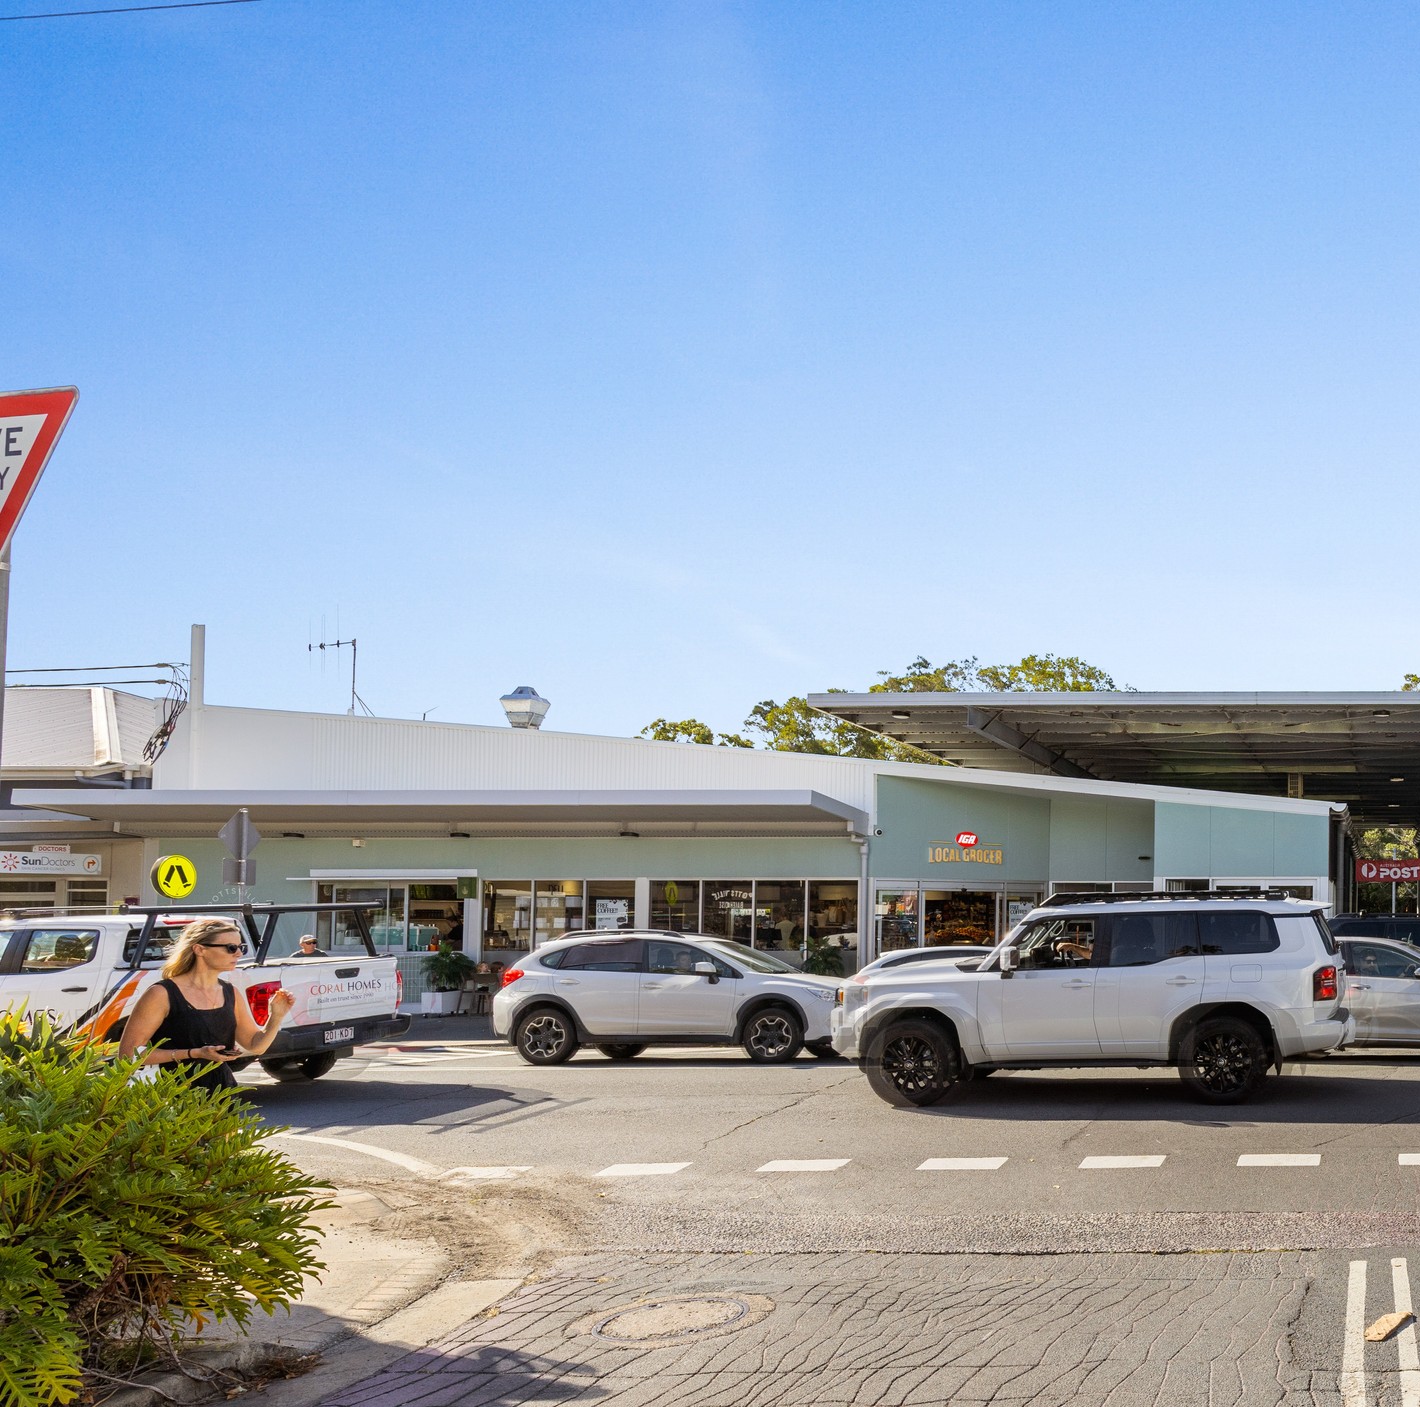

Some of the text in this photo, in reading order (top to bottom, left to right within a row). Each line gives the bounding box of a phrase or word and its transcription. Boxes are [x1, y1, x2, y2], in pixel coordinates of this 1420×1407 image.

[958, 834, 976, 845] IGA
[21, 856, 76, 867] SunDoctors
[928, 847, 1002, 864] LOCAL GROCER
[1380, 866, 1420, 879] POST
[208, 887, 259, 905] OTTSILL
[310, 983, 344, 996] CORAL
[347, 979, 382, 992] HOMES
[317, 997, 329, 1005] Built
